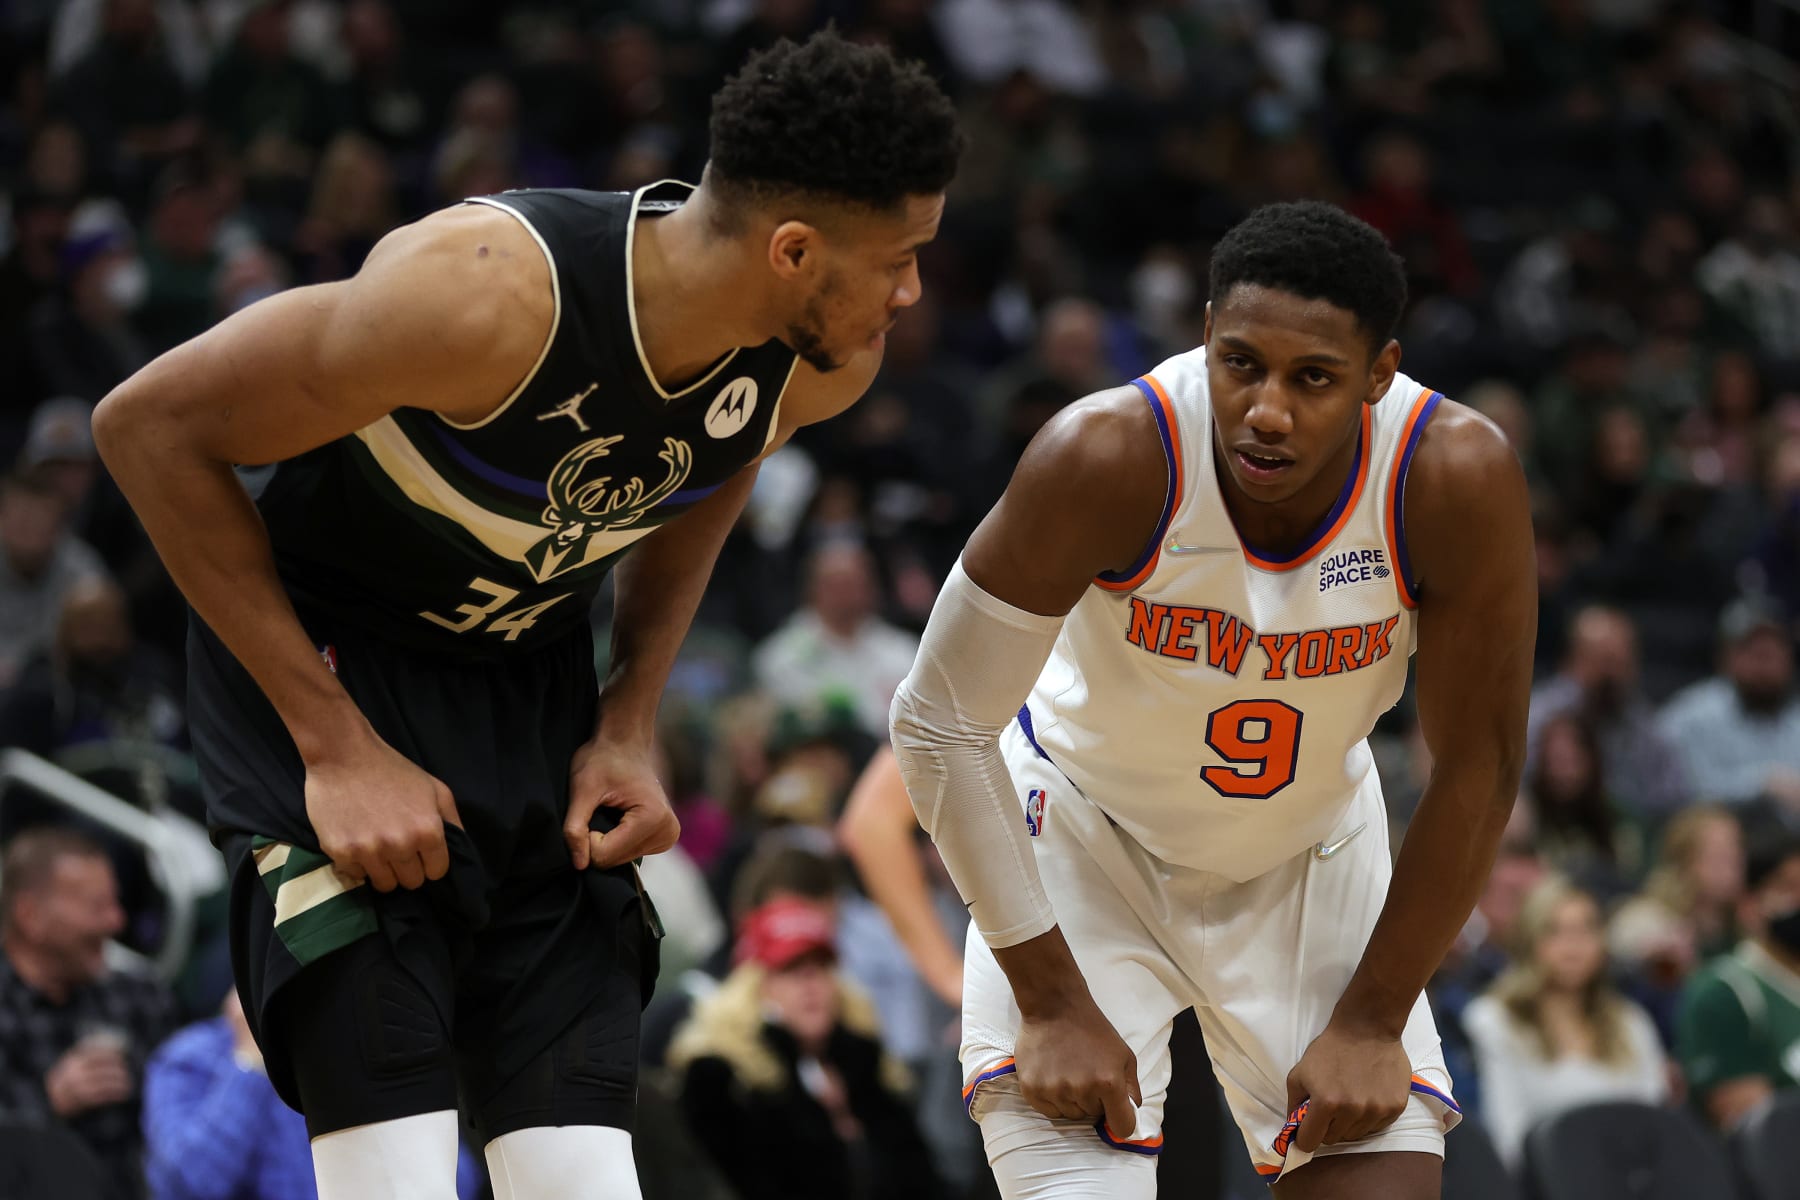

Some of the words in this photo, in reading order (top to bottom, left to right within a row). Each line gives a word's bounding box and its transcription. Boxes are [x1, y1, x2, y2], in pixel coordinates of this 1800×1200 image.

[1319, 549, 1385, 576] SQUARE
[1319, 566, 1372, 592] SPACE
[417, 576, 576, 641] 34
[1126, 594, 1254, 680] NEW
[1256, 613, 1400, 681] YORK
[1200, 699, 1304, 799] 9
